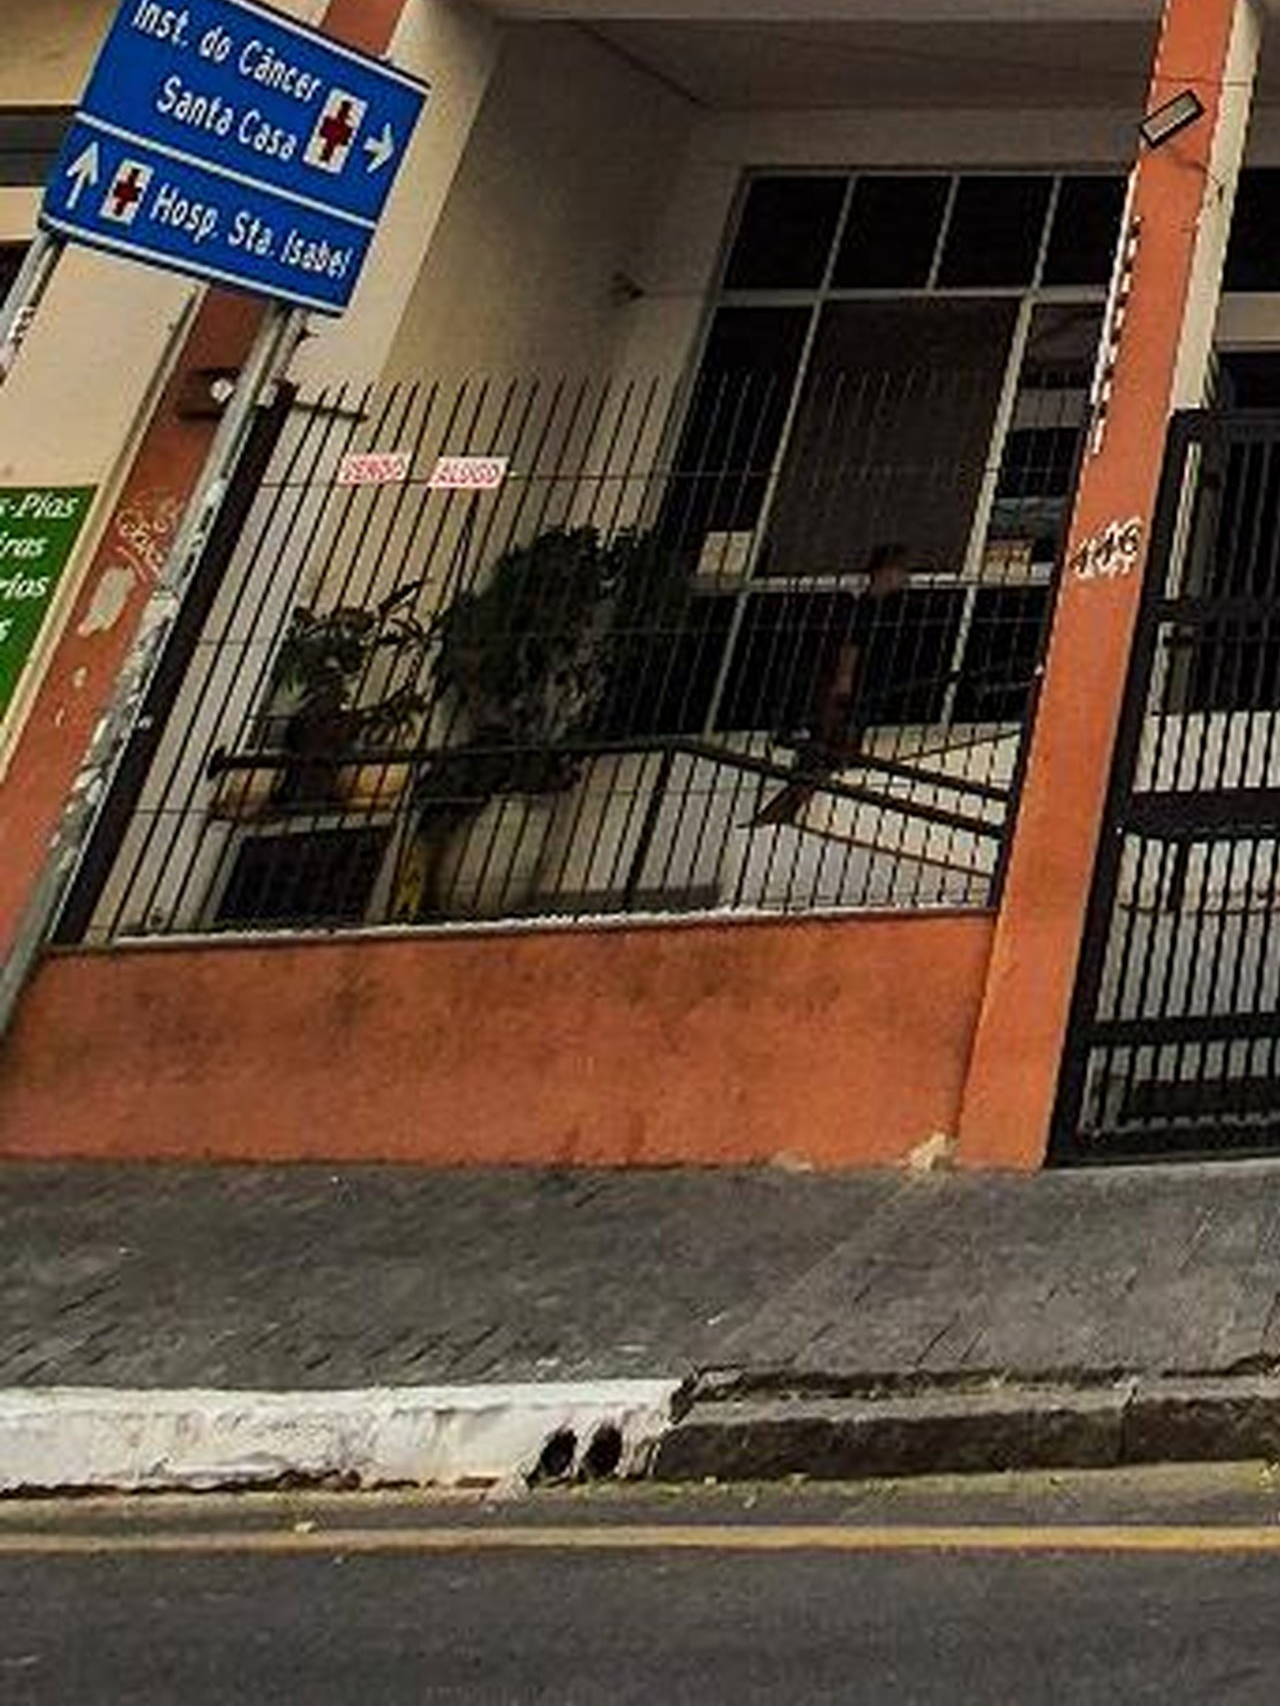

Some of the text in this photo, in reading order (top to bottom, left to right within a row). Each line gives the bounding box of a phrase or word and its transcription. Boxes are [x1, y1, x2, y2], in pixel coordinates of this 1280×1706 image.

[199, 25, 233, 63] do
[238, 39, 322, 103] Câncer
[156, 74, 298, 162] Santa Casa
[150, 182, 354, 280] Hosp. Sta. Isabel
